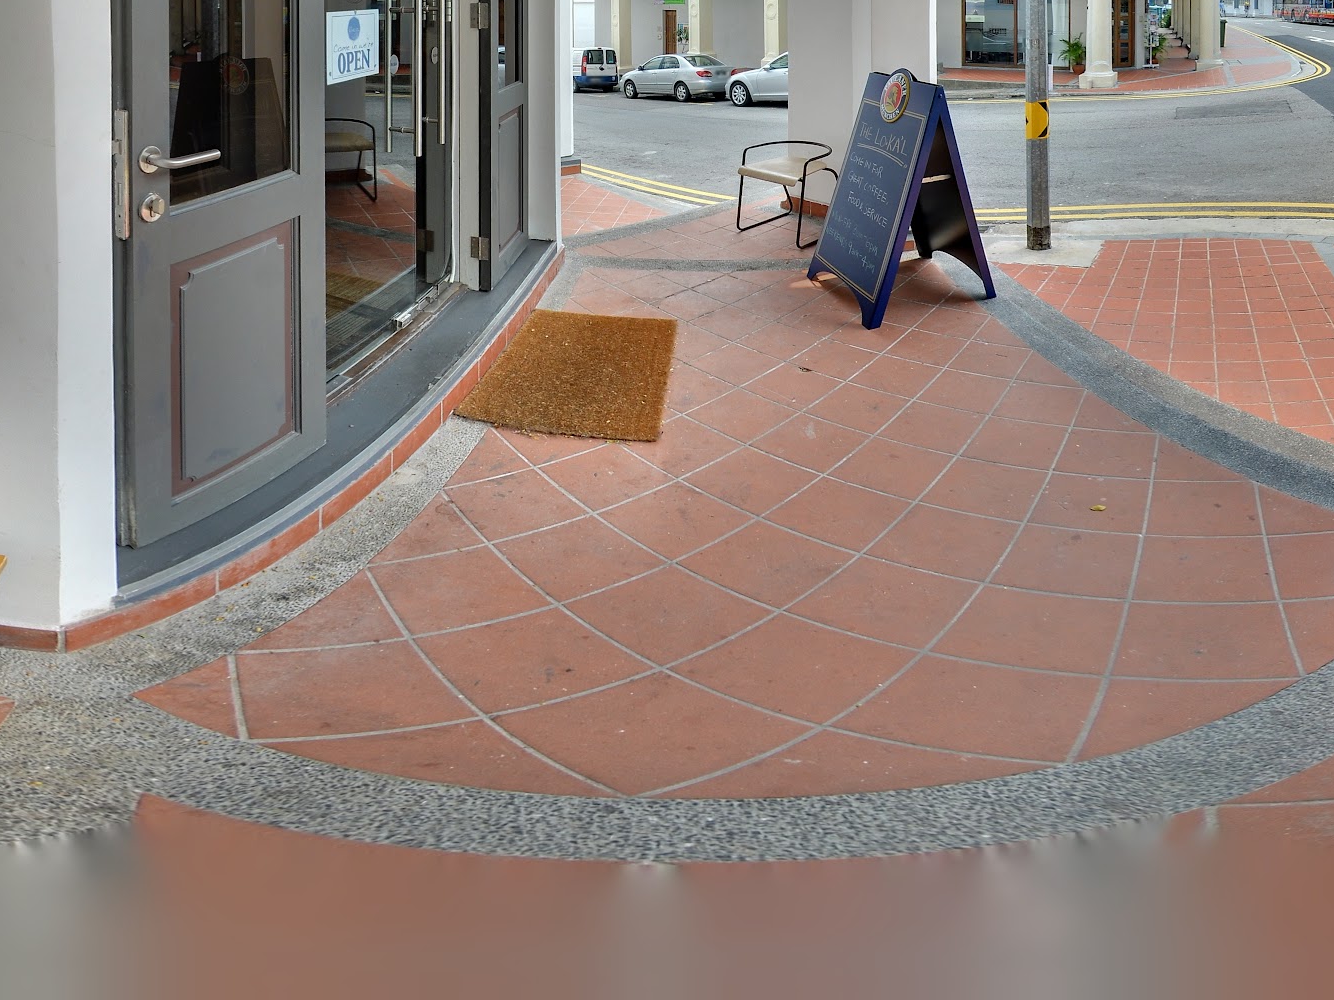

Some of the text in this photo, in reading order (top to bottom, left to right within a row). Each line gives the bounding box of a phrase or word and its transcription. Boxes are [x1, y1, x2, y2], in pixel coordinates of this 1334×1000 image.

[337, 48, 371, 75] OPEN
[858, 121, 873, 141] THE
[850, 152, 864, 166] COME
[871, 163, 884, 178] FOR
[847, 171, 864, 188] GREAT
